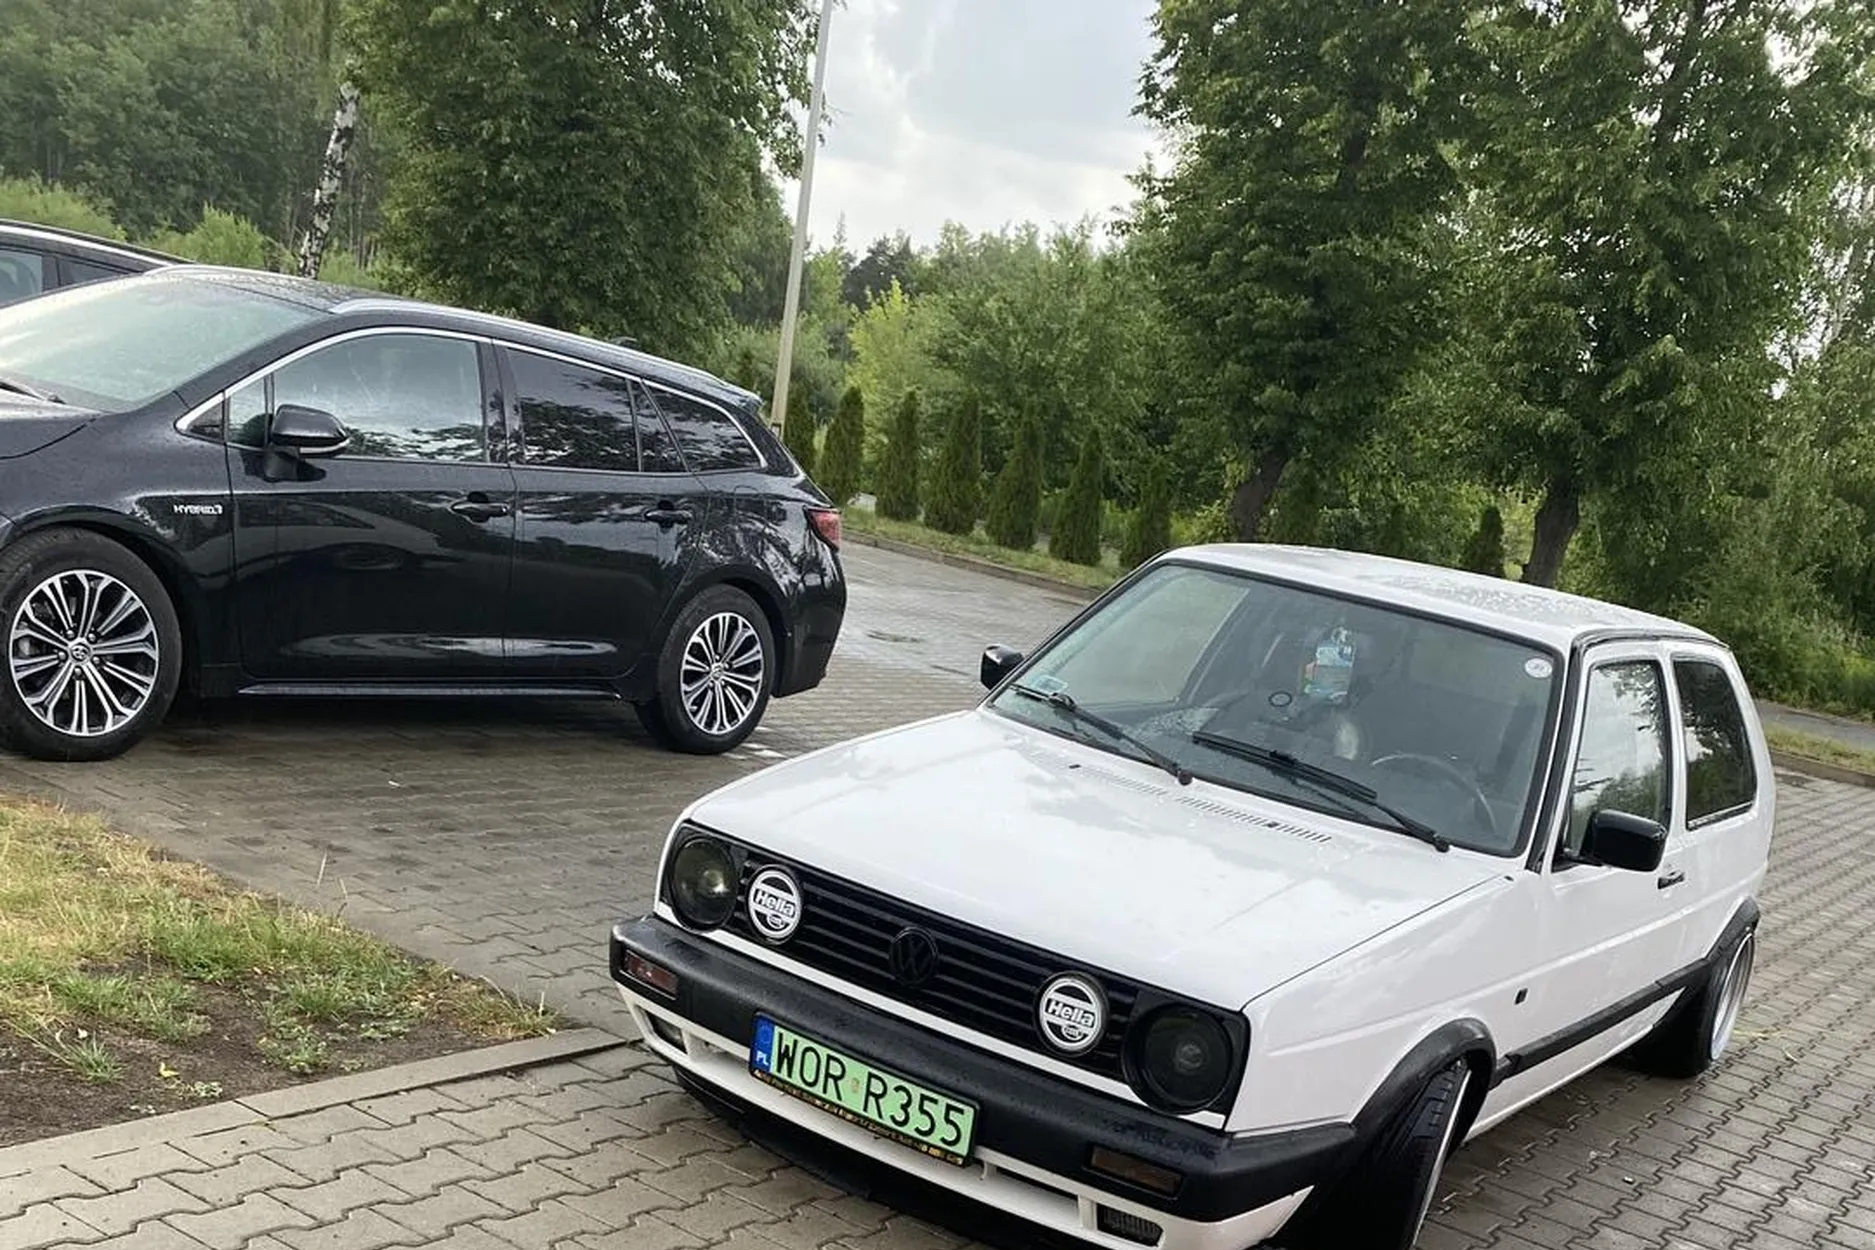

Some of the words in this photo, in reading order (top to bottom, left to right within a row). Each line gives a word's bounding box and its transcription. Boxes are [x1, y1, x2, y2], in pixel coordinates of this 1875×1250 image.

[173, 504, 214, 515] HYBRID
[755, 890, 795, 917] Hella
[1048, 1000, 1094, 1027] Hella
[756, 1050, 769, 1066] PL
[776, 1032, 846, 1102] WOR
[862, 1071, 965, 1148] R355
